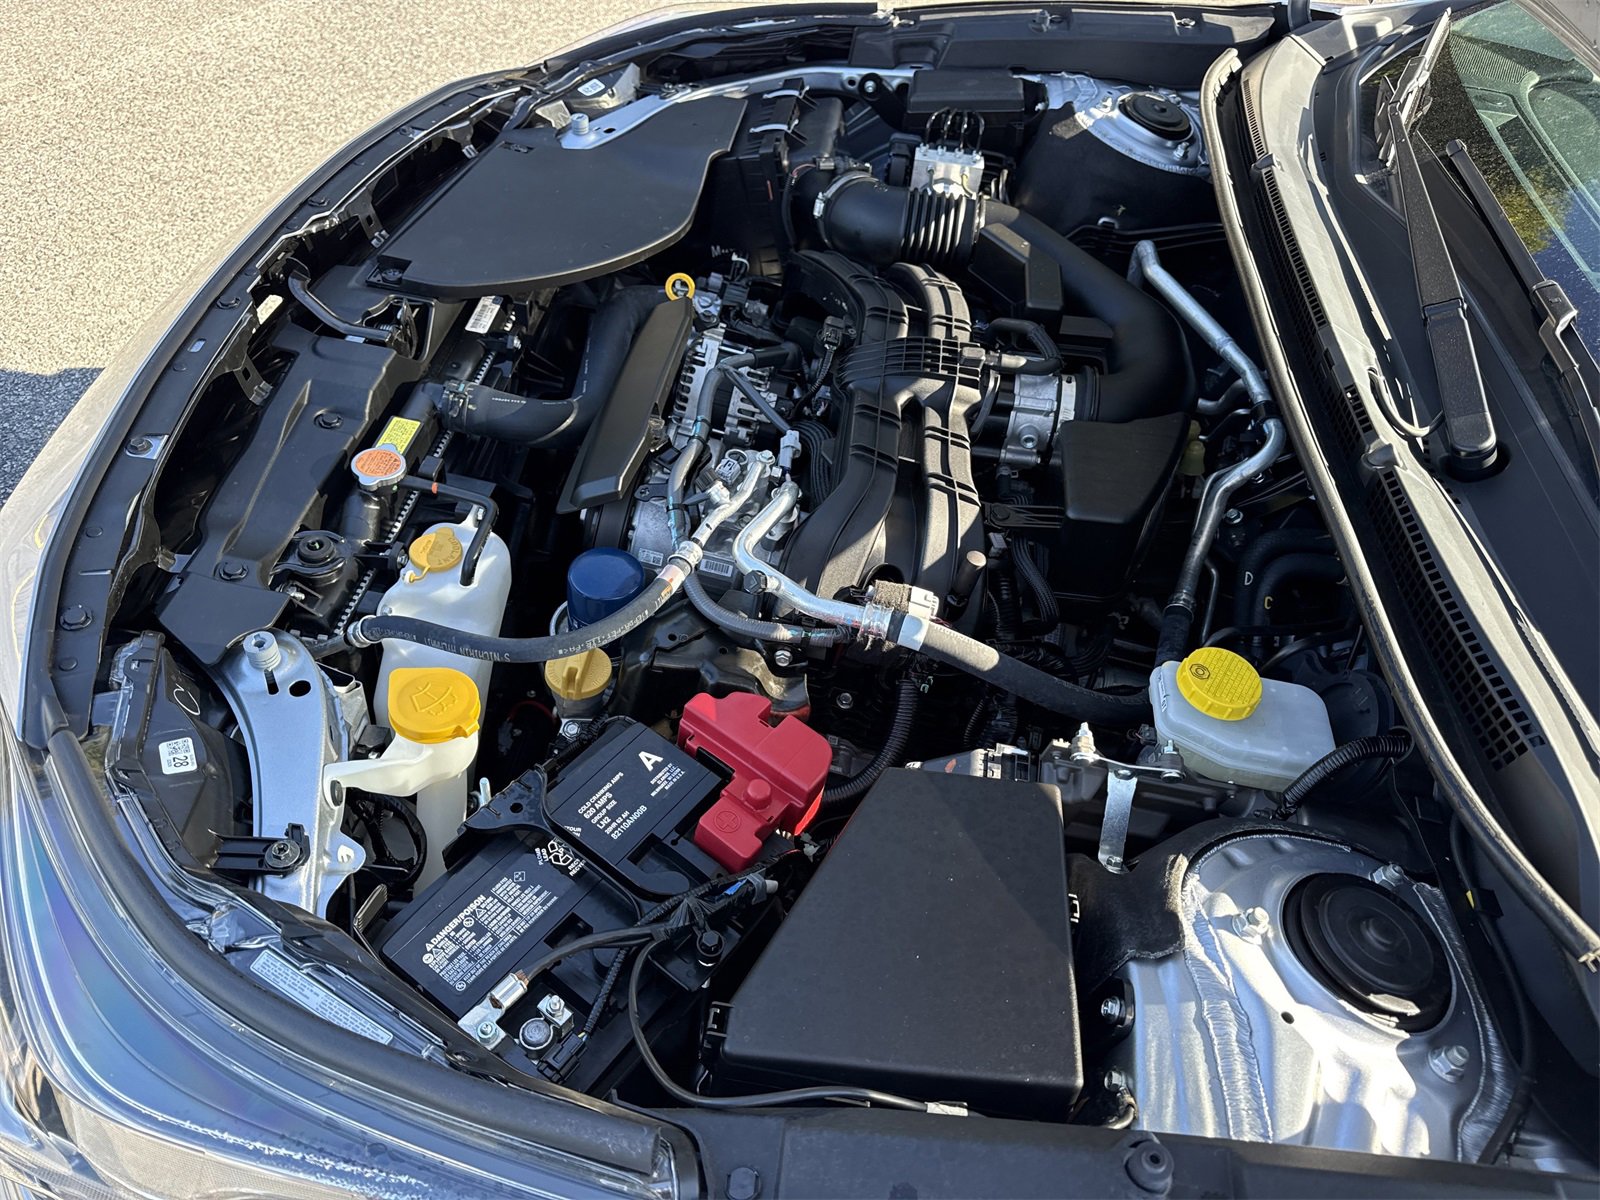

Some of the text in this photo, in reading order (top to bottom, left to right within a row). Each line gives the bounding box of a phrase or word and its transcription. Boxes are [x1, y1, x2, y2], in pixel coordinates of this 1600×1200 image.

[1244, 571, 1254, 586] D
[1264, 596, 1273, 610] C
[173, 755, 189, 768] 28
[638, 750, 664, 772] A
[577, 800, 592, 814] COLD
[610, 771, 624, 784] AMPS
[583, 791, 613, 819] 620 AMPS
[590, 799, 618, 824] GROUP SIZE
[596, 816, 612, 829] LN2
[430, 894, 487, 946] DANGER/POISON
